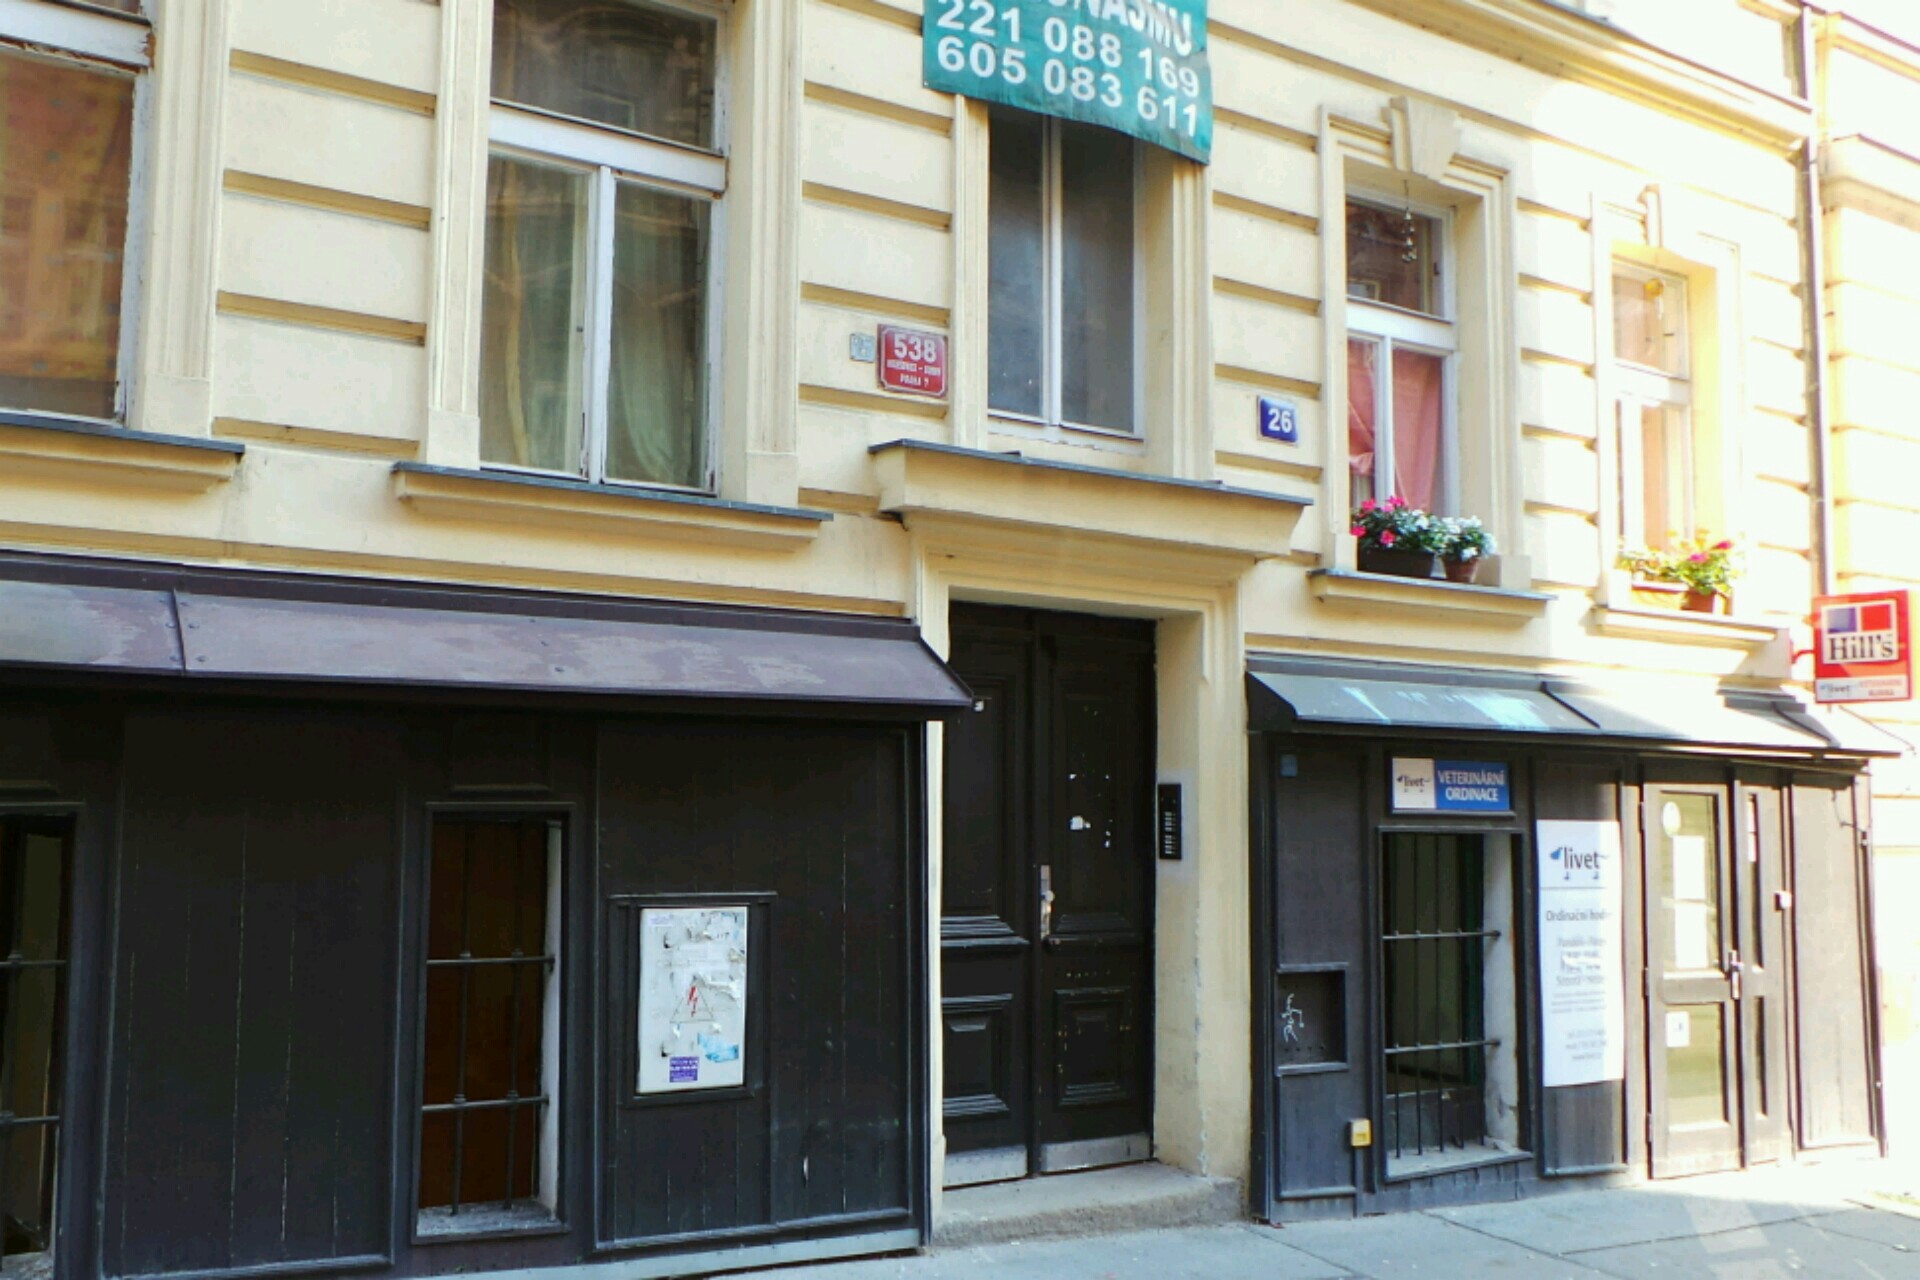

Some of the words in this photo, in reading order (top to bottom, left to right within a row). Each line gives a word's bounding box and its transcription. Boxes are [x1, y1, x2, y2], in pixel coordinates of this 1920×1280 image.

[937, 0, 1021, 42] 221
[1043, 17, 1122, 68] 088
[1138, 48, 1200, 98] 169
[937, 37, 1027, 84] 605
[1043, 59, 1123, 108] 083
[1137, 86, 1197, 137] 611
[894, 333, 937, 363] 538
[1268, 408, 1292, 433] 26
[1828, 634, 1893, 660] Hill's
[1445, 788, 1498, 802] ORDINACE
[1564, 847, 1600, 869] livet
